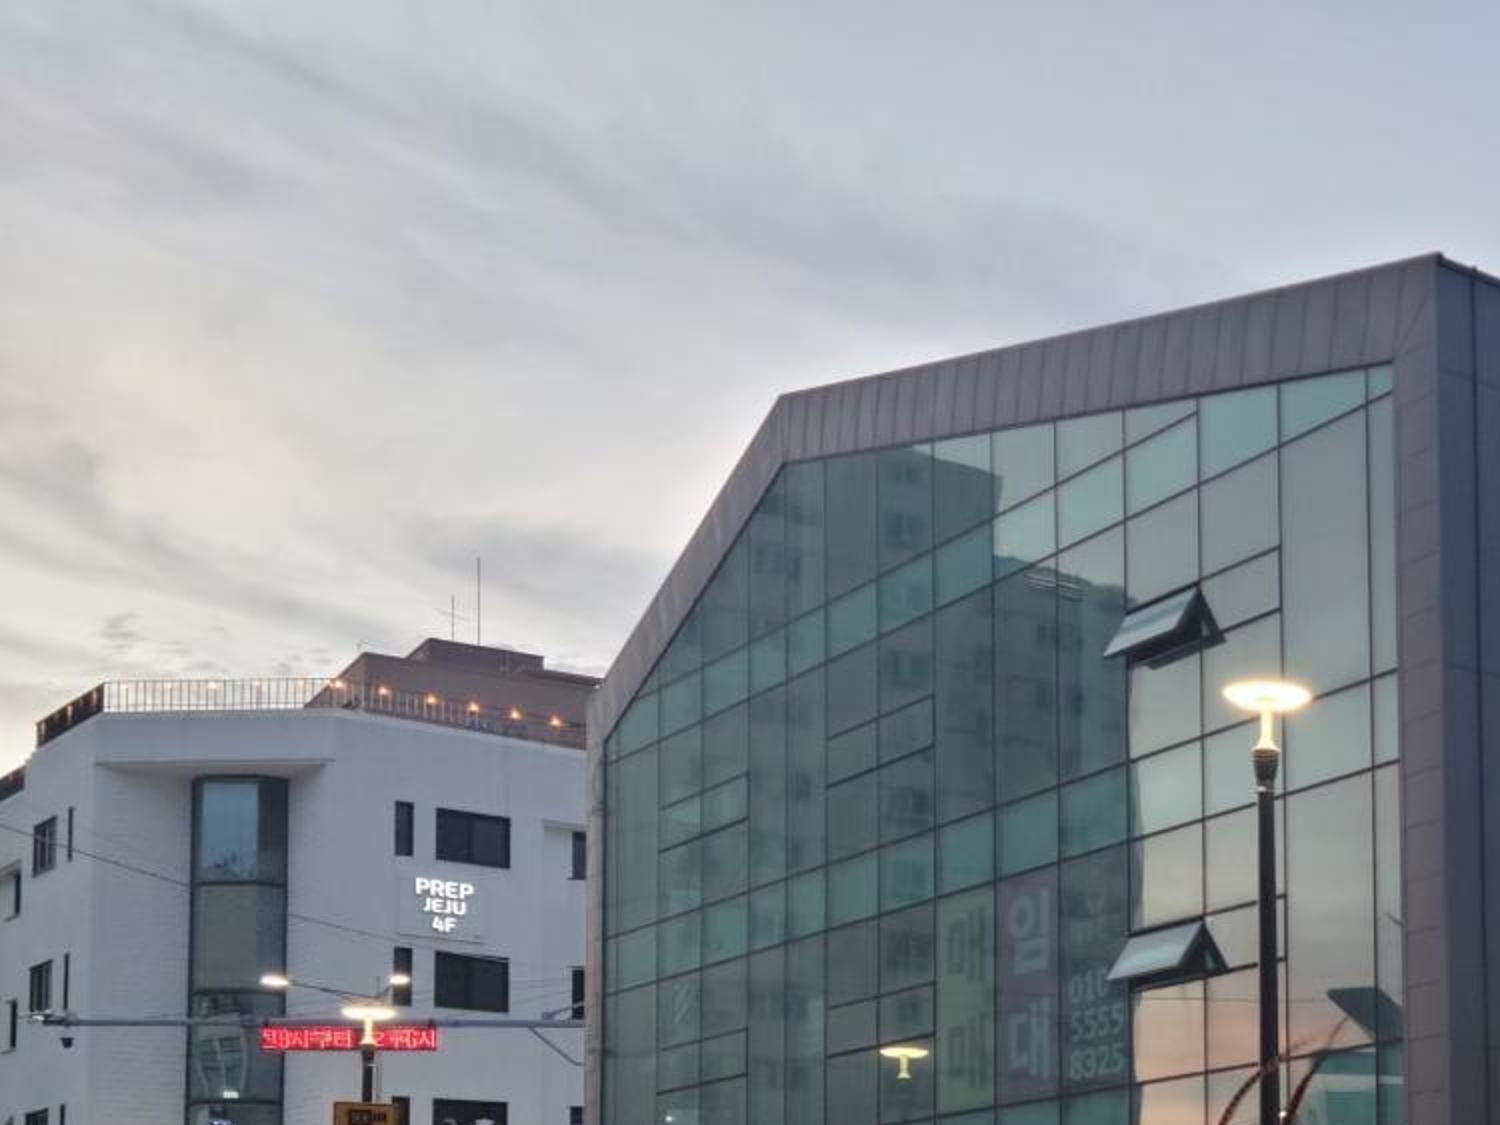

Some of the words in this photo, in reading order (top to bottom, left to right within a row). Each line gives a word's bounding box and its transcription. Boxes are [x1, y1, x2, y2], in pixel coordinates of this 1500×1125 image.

[416, 877, 474, 899] PREP
[423, 897, 467, 915] JEJU
[431, 916, 457, 933] 4F
